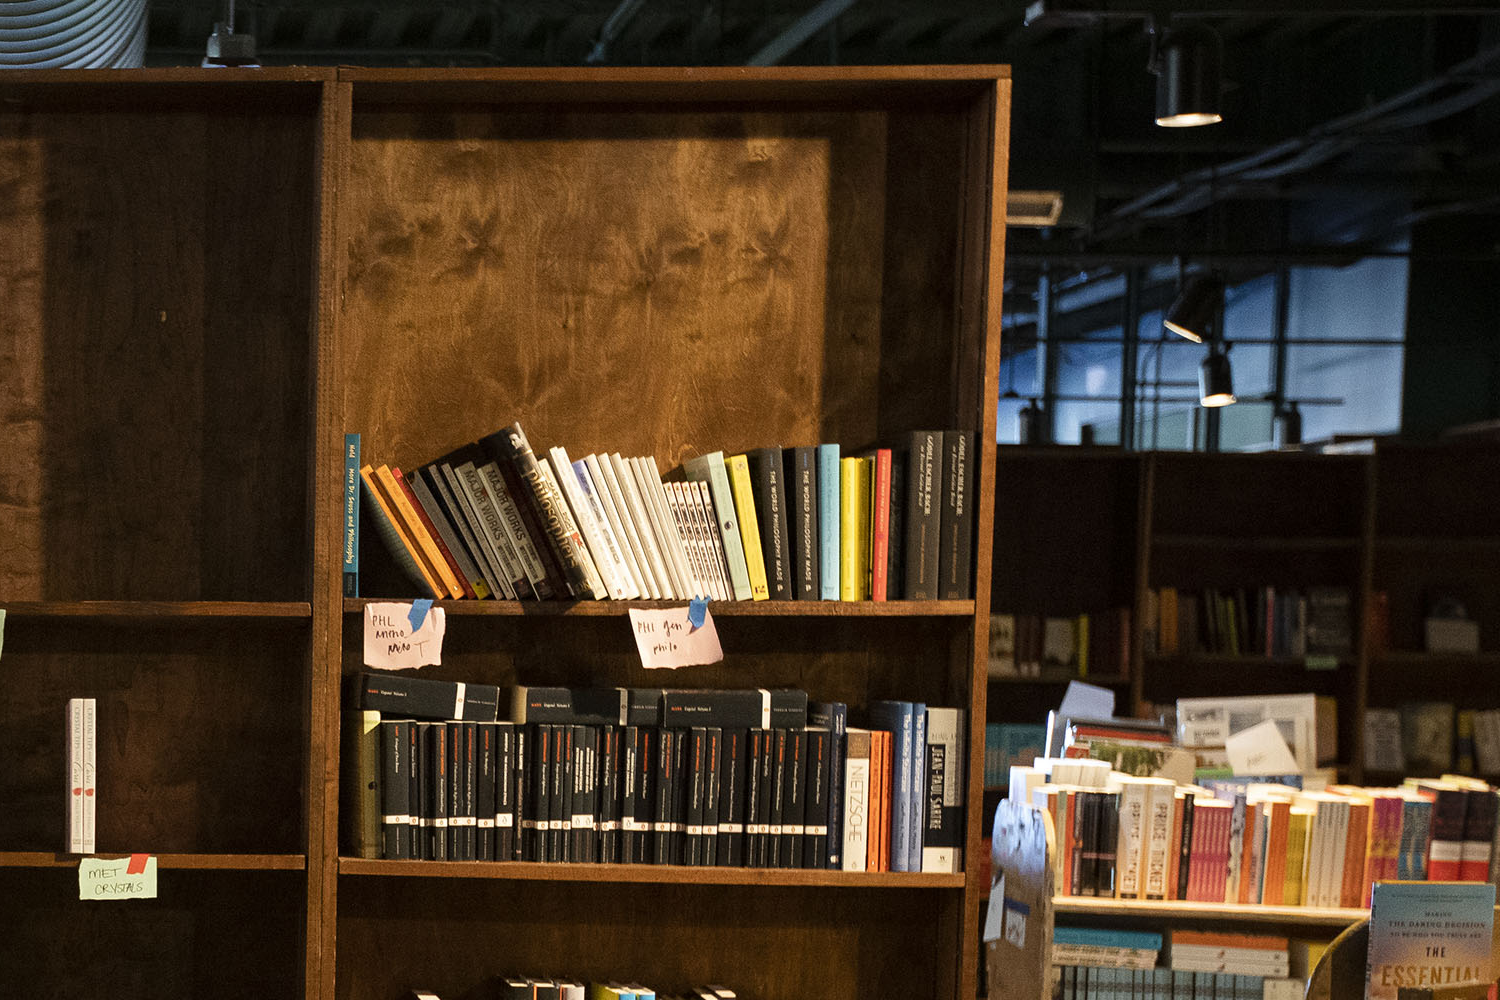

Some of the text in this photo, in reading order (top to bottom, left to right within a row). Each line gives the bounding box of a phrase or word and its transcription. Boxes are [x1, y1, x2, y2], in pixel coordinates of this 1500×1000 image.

[464, 470, 504, 542] MAJOR WORKS
[486, 469, 526, 541] MAJOR WORKS
[770, 485, 778, 512] WORLD
[345, 527, 353, 564] Philosophy
[772, 513, 782, 559] PHILOSOPHY
[803, 513, 811, 559] PHILOSOPHY
[775, 560, 783, 581] MADE
[901, 714, 911, 792] The Infinite Staircase
[914, 714, 924, 792] The Infinite Staircase
[849, 766, 864, 841] NIETZSCHE
[929, 746, 943, 830] JEAN-PAUL SARTRE
[88, 868, 122, 878] MET
[94, 883, 143, 895] CRYSTALS
[1426, 947, 1446, 957] THE
